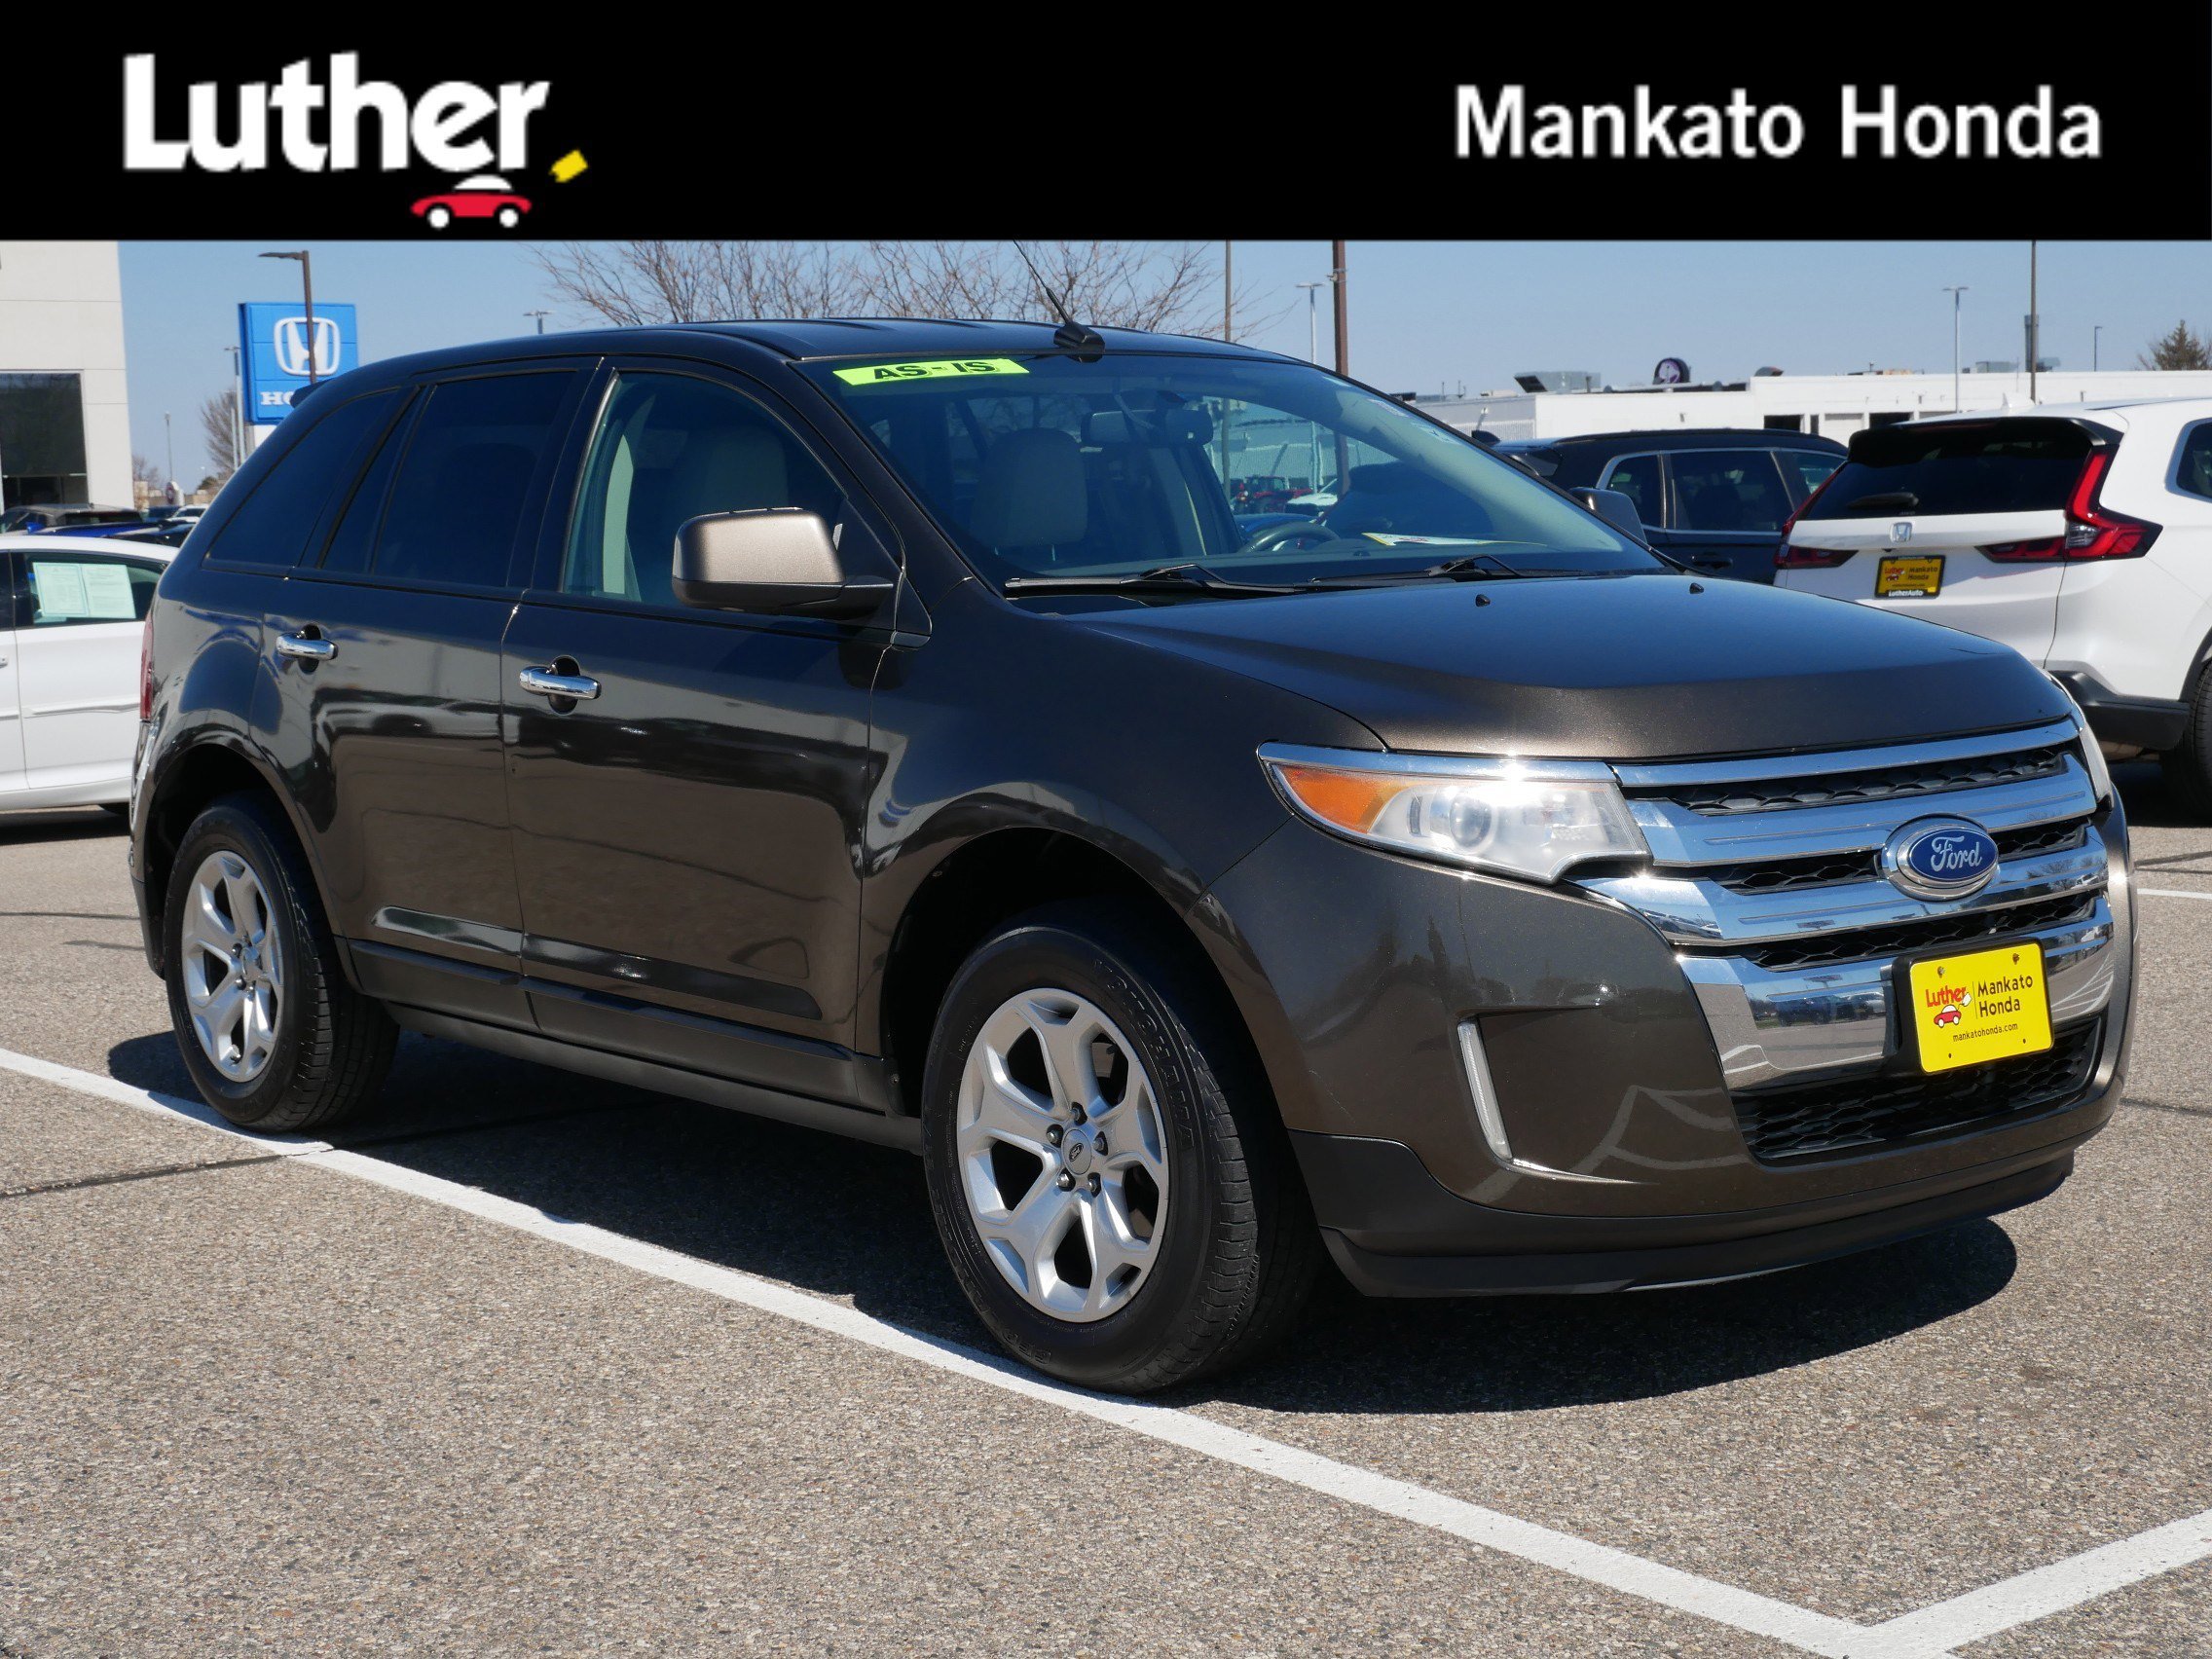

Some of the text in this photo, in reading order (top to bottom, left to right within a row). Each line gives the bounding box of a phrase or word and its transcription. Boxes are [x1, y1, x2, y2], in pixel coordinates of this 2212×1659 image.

[1931, 835, 1982, 871] Ford
[1925, 985, 1967, 1008] Luther
[1977, 975, 2034, 998] Mankato
[1979, 996, 2021, 1018] Honda
[1952, 1022, 2019, 1043] mankatohonda.com
